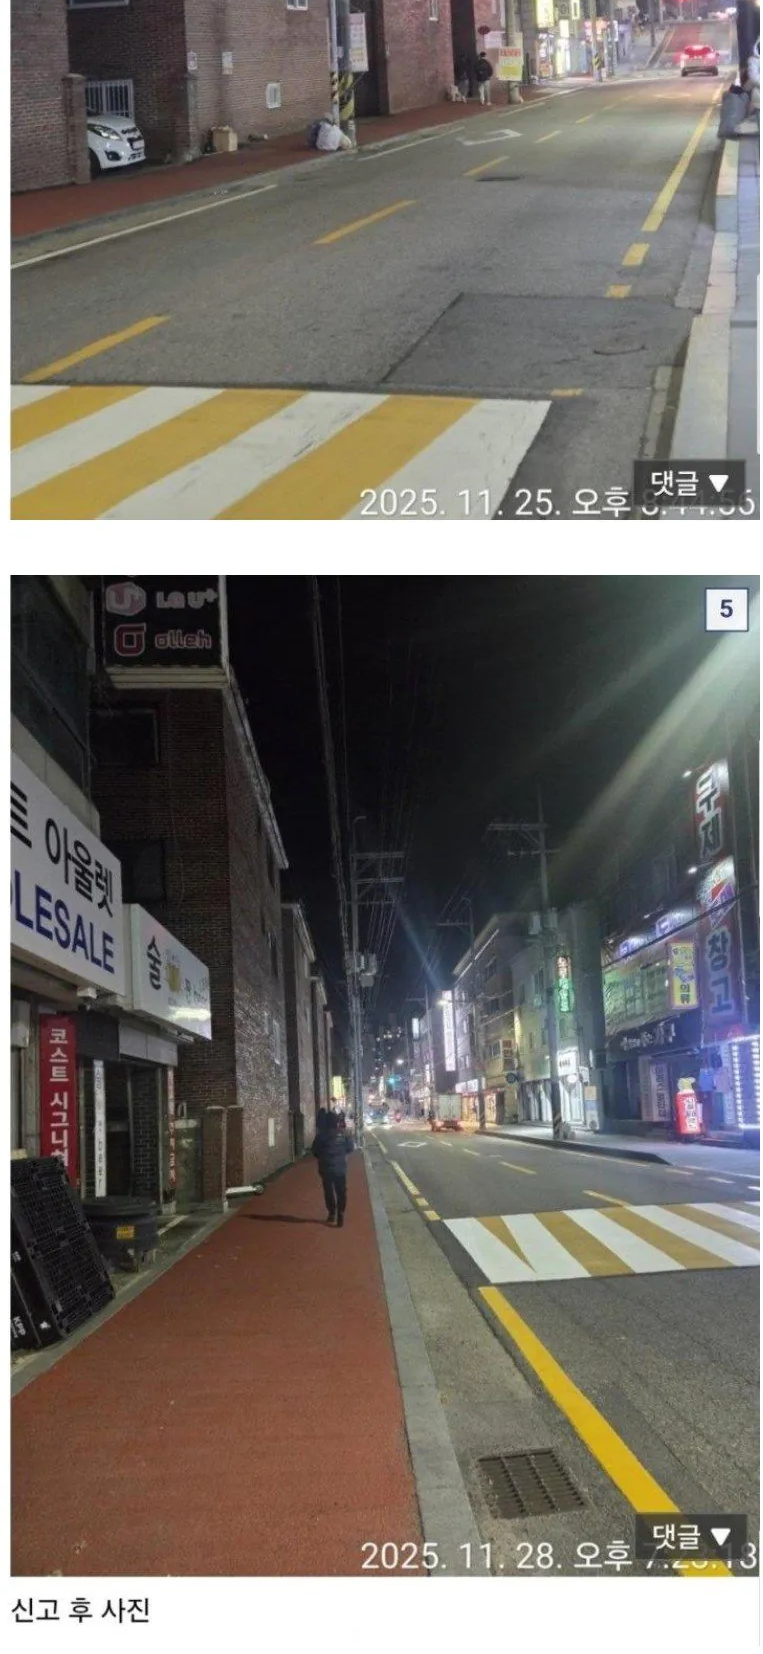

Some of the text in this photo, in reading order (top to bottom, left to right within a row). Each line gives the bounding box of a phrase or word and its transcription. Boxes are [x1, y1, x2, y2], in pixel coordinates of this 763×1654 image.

[154, 629, 213, 650] olleh
[44, 817, 114, 919] 아울렛
[11, 869, 116, 974] LESALE
[147, 934, 163, 991] 술
[705, 929, 734, 1017] 창고
[49, 1027, 69, 1082] 코스트
